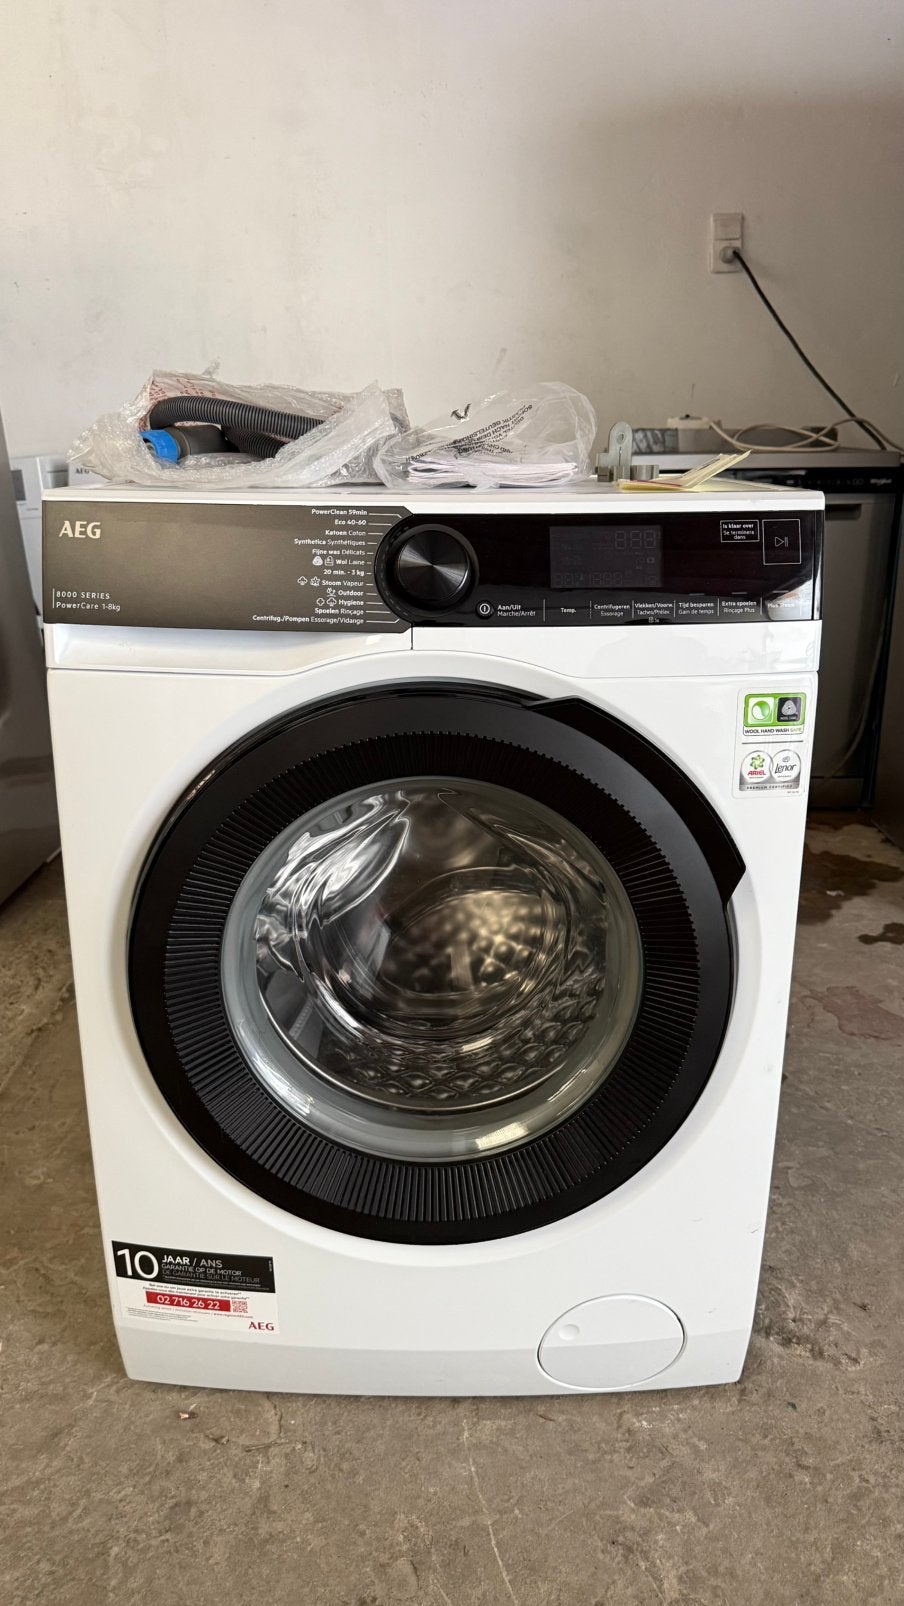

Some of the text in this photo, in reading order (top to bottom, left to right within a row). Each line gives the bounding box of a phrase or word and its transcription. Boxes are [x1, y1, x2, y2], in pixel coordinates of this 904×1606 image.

[58, 520, 101, 539] AEG
[294, 538, 326, 546] Synthetica
[357, 569, 365, 577] kg
[81, 592, 110, 600] SERIES
[56, 602, 121, 612] PowerCare 1-8kg
[594, 603, 631, 611] Centrifugeren
[252, 615, 364, 625] Centrifug./Pompen Essorage/Vidange
[774, 763, 797, 774] Lenor
[117, 1248, 159, 1279] 10
[161, 1255, 190, 1265] JAAR
[200, 1259, 223, 1268] ANS
[161, 1263, 195, 1272] GARANTIE
[156, 1295, 220, 1309] 02 716 26 22
[248, 1321, 275, 1331] AEG
